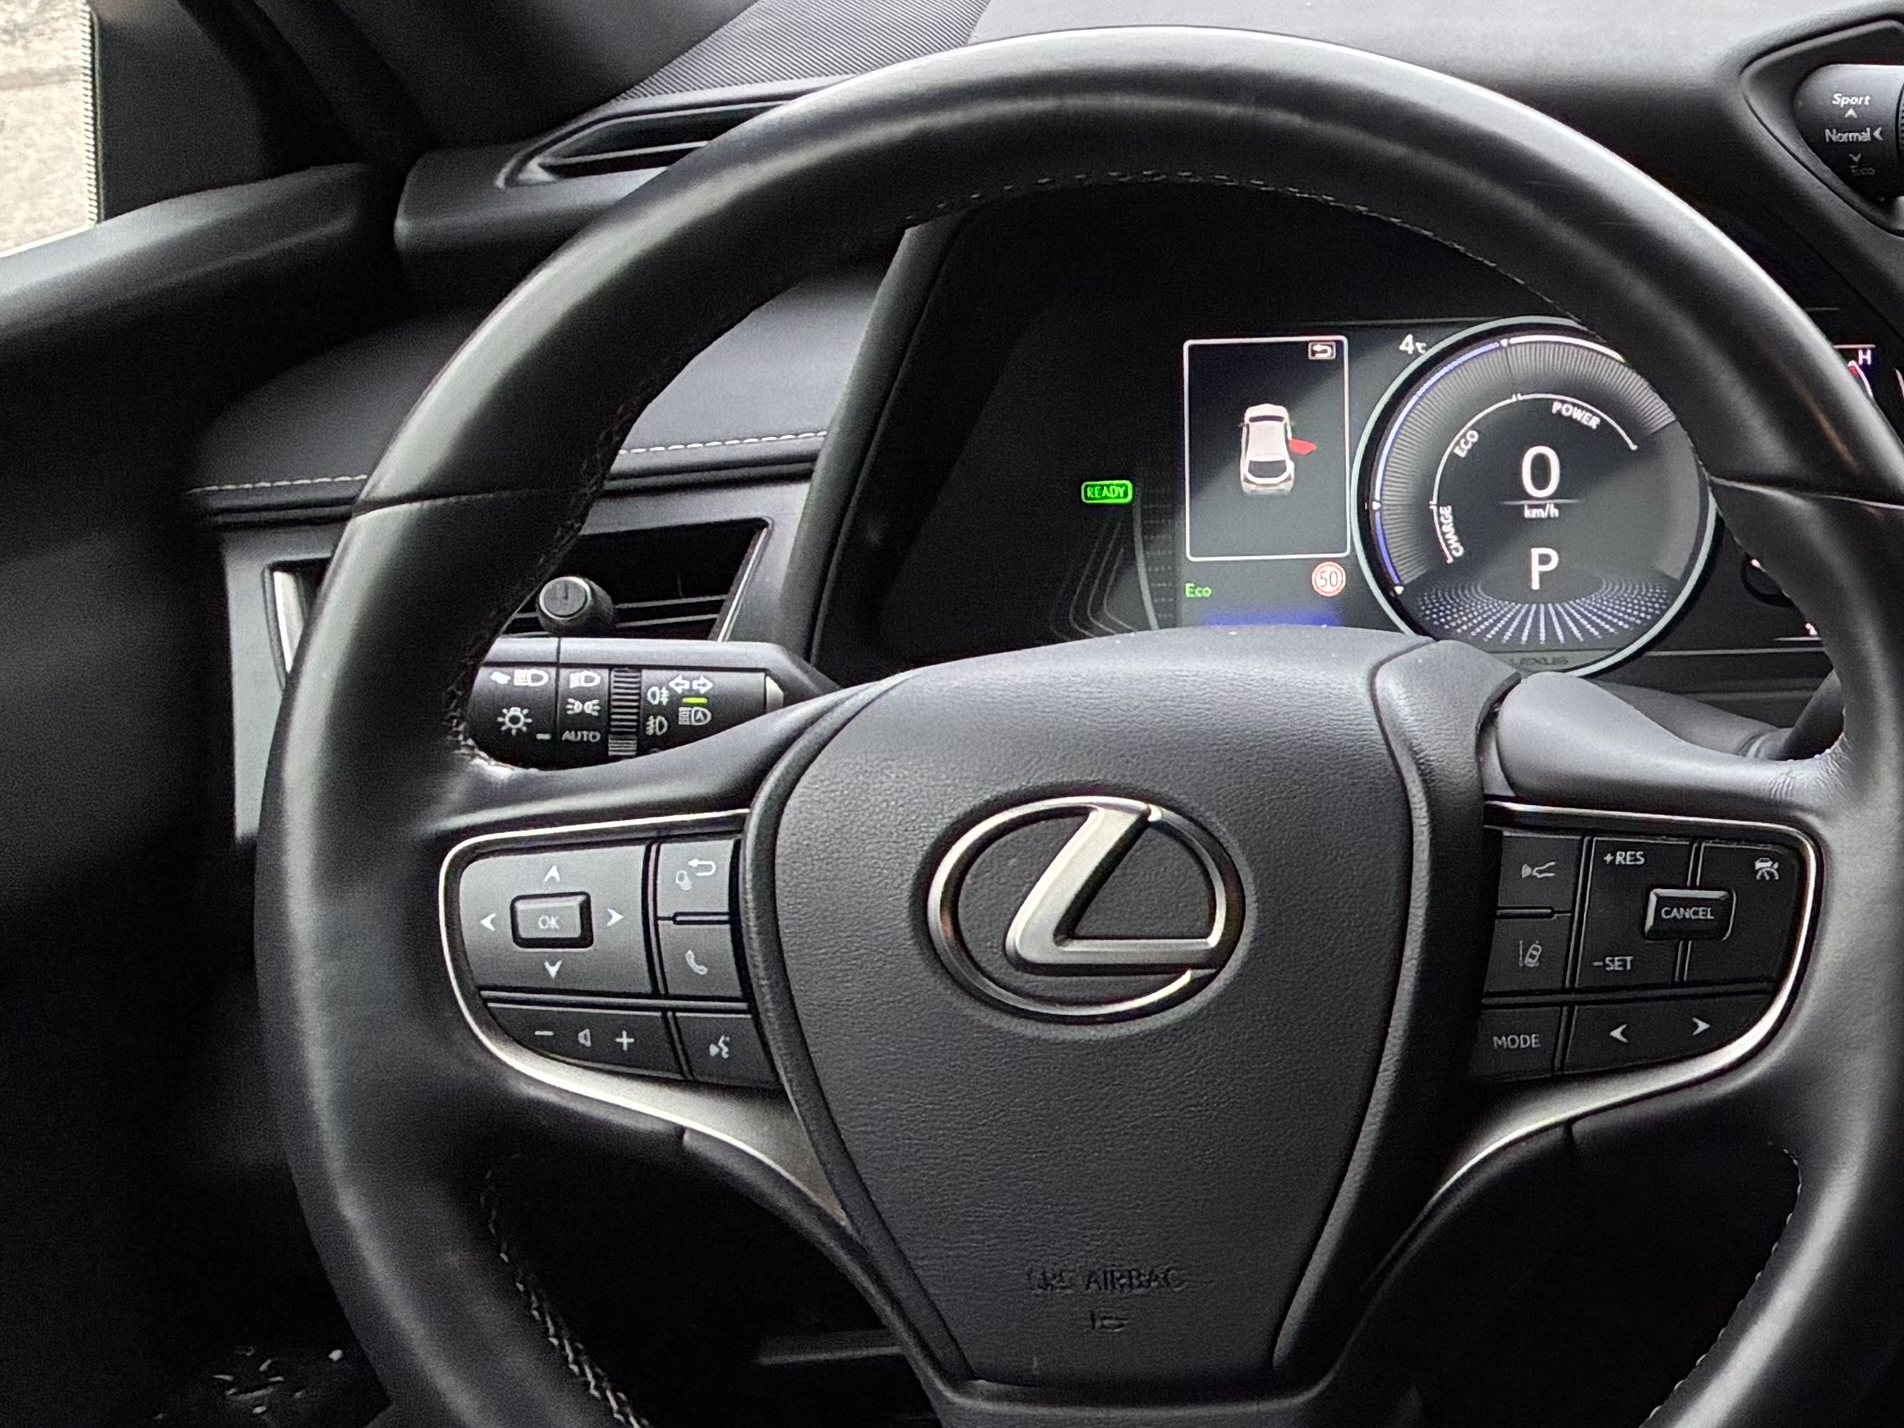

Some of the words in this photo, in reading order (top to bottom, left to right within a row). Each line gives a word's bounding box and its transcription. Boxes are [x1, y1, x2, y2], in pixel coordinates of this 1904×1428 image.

[1831, 93, 1871, 108] Sport
[1825, 127, 1871, 143] Normal
[1858, 349, 1872, 365] H
[1552, 400, 1600, 430] POWER
[1453, 429, 1480, 458] ECO
[1521, 445, 1561, 499] 0
[1086, 485, 1126, 499] READY
[1523, 504, 1560, 519] km/h
[1439, 505, 1465, 558] CHARGE
[1530, 547, 1560, 591] P
[1319, 570, 1340, 588] 50
[1184, 582, 1213, 598] Eco
[561, 730, 601, 743] AUTO
[1660, 906, 1715, 920] CANCEL
[537, 915, 562, 930] OK
[1492, 1035, 1541, 1049] MODE
